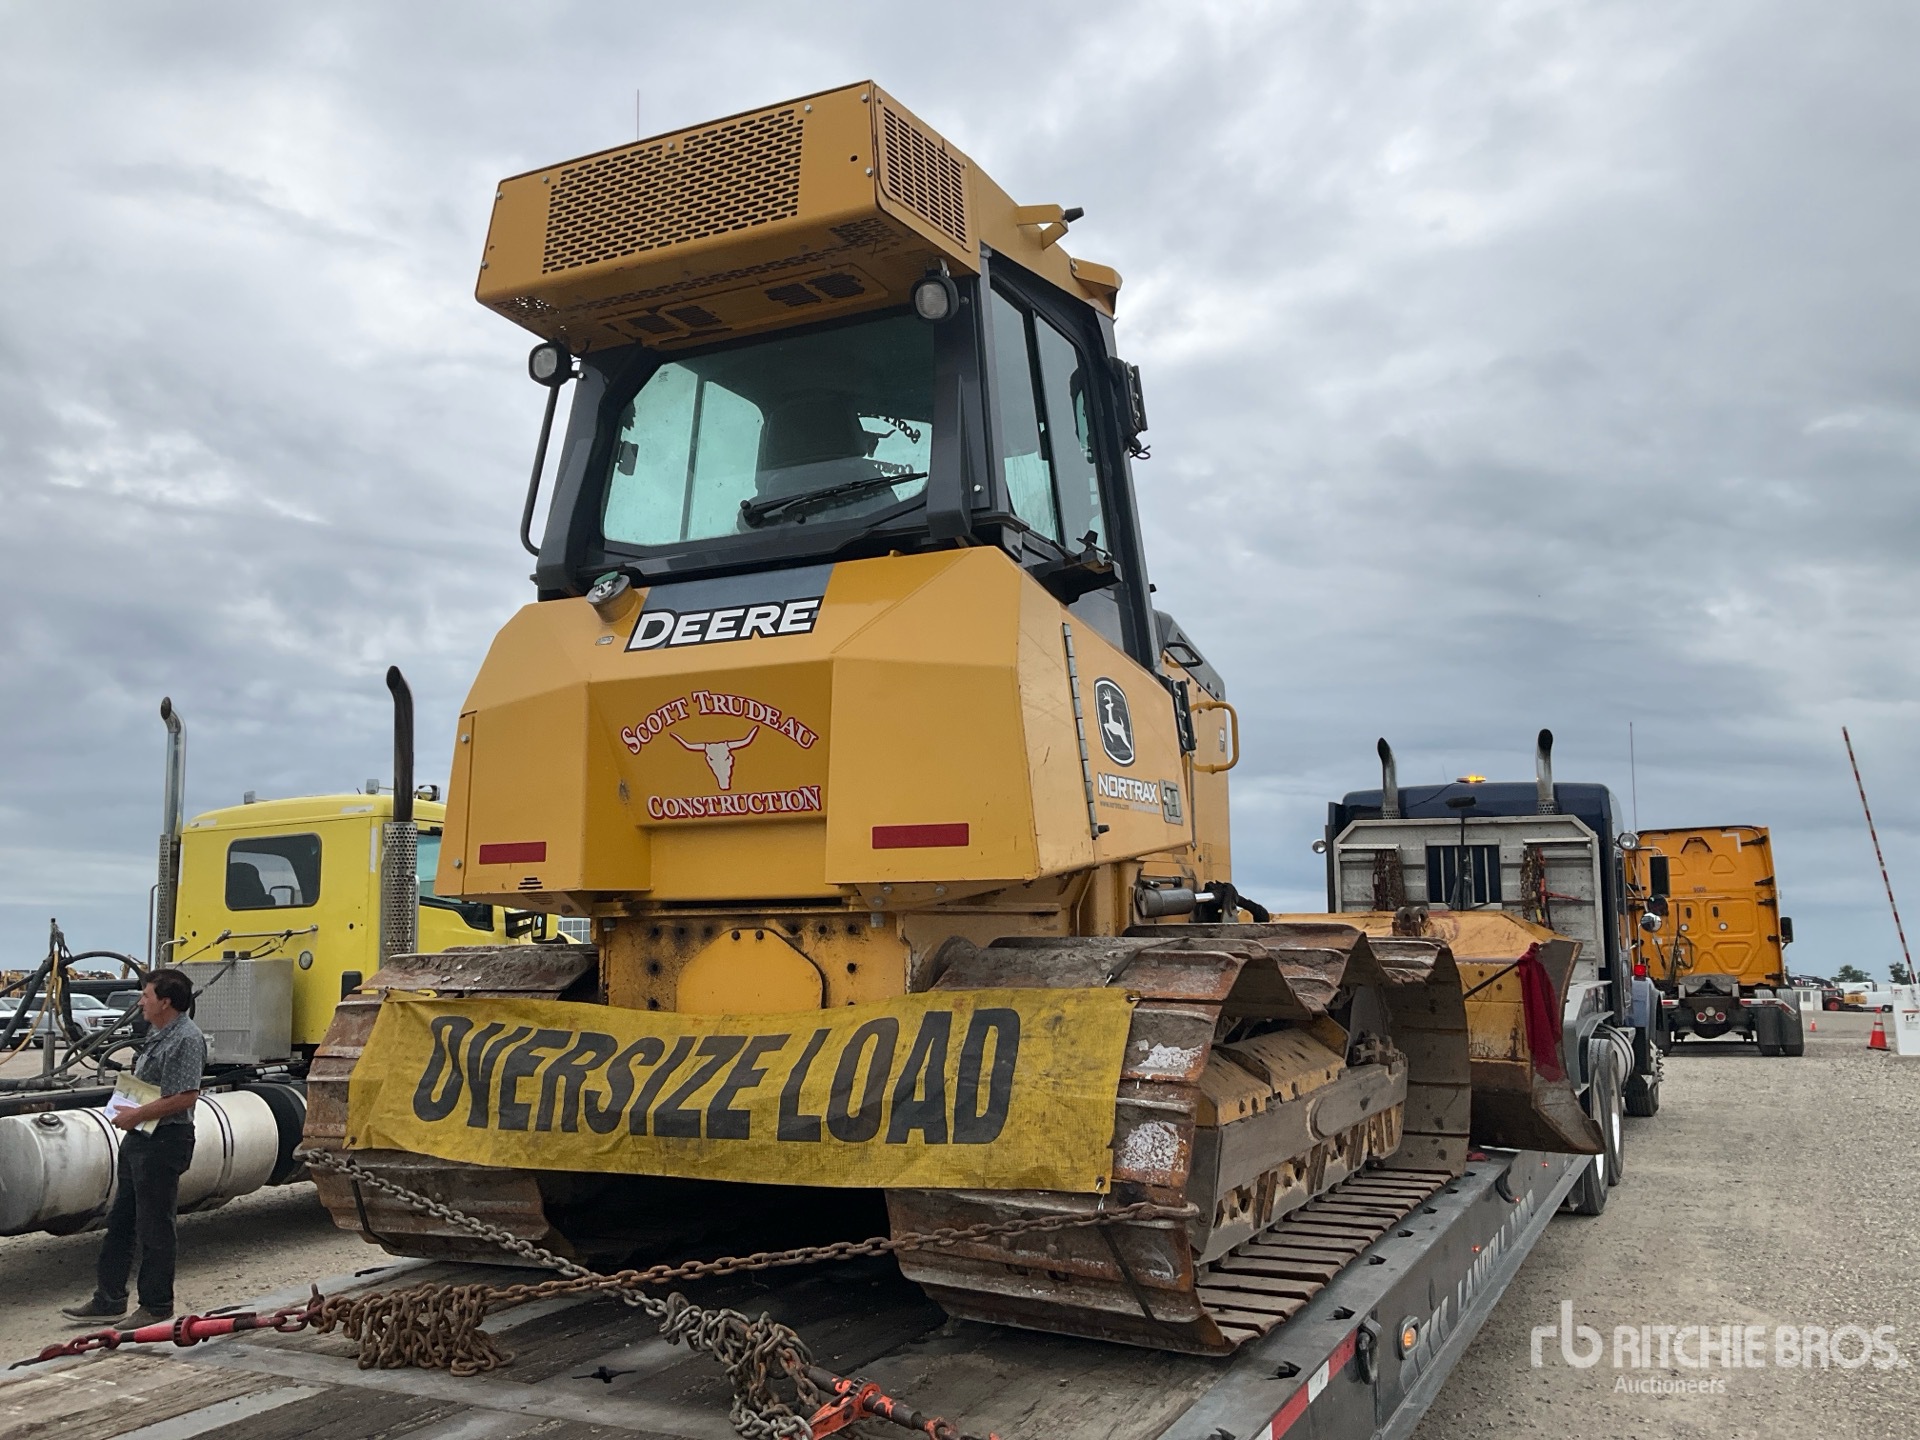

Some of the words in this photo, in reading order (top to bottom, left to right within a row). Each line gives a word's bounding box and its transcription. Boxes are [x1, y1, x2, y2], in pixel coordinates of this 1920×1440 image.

[627, 598, 820, 650] DEERE
[621, 698, 690, 755] SCOTT
[692, 689, 819, 749] TRUDEAU
[647, 785, 822, 820] CONSTRUCTION
[1097, 772, 1159, 805] NORTRAX
[412, 1014, 793, 1140] OVERSIZE
[776, 1007, 1022, 1145] LOAD
